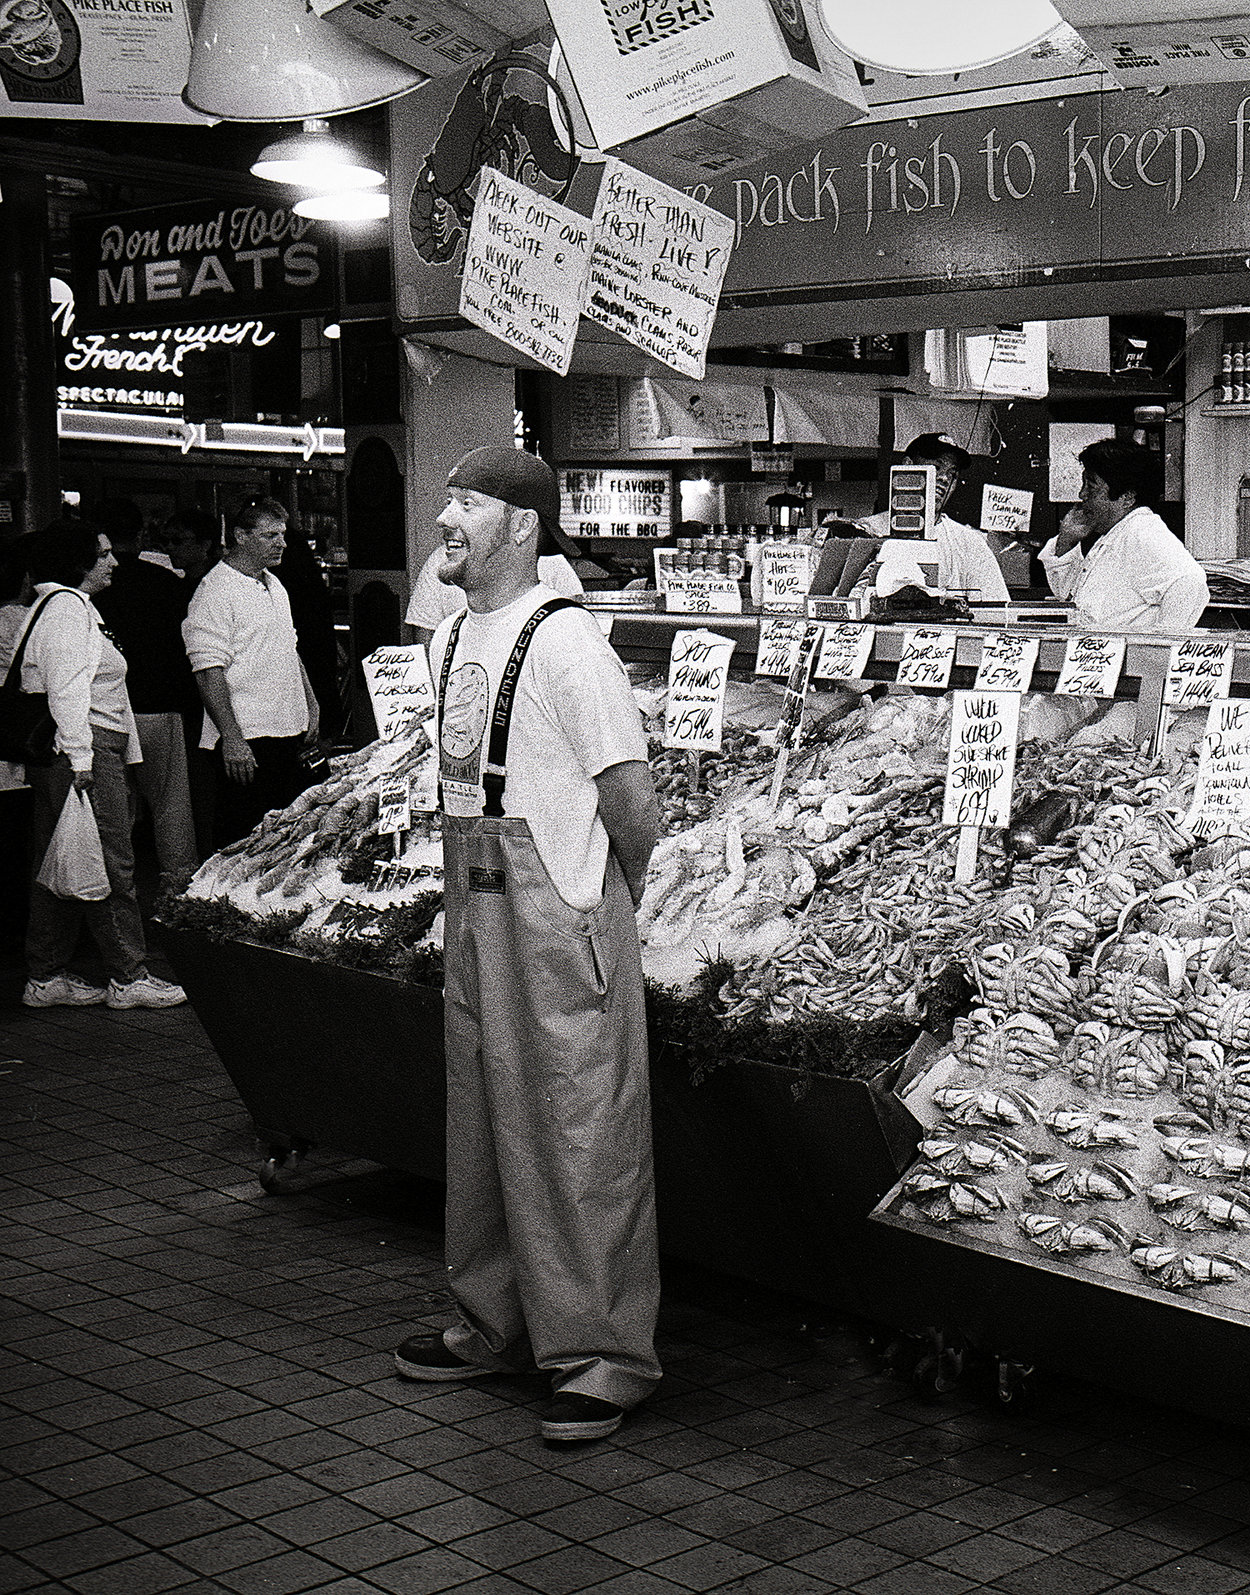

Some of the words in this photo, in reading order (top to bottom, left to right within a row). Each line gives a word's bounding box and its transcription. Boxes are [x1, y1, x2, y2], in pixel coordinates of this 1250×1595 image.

[73, 0, 100, 11] PIKE
[104, 0, 142, 12] PLACE
[145, 1, 174, 14] FISH
[625, 2, 701, 44] FISH
[626, 50, 736, 101] www.pikeplacefish.com
[731, 148, 842, 250] pack
[860, 135, 961, 235] fish
[978, 126, 1036, 202] to
[1063, 115, 1207, 211] keep
[607, 171, 656, 220] BETTER
[656, 205, 706, 243] THAN
[101, 225, 161, 261] Don
[167, 211, 226, 254] and
[488, 212, 545, 259] WEBSITE
[554, 252, 565, 271] @
[559, 224, 588, 252] OUR
[98, 242, 321, 306] MEATS
[472, 256, 500, 289] PIKE
[499, 272, 533, 308] PLACE
[623, 284, 673, 323] LOBSTER
[610, 479, 665, 494] FLAVORED
[572, 494, 612, 516] WOOD
[618, 494, 663, 517] CHIPS
[579, 522, 600, 536] FOR
[611, 522, 631, 536] THE
[636, 522, 658, 537] BBQ
[671, 634, 730, 664] SPOT
[1076, 636, 1109, 651] FRESH
[1177, 639, 1230, 657] CHILEAN
[367, 648, 415, 667] BOILED
[1170, 657, 1196, 674] SEA
[1196, 660, 1226, 677] BASS
[373, 665, 409, 685] BABY
[1220, 706, 1249, 732] WE
[1225, 760, 1244, 772] ALL
